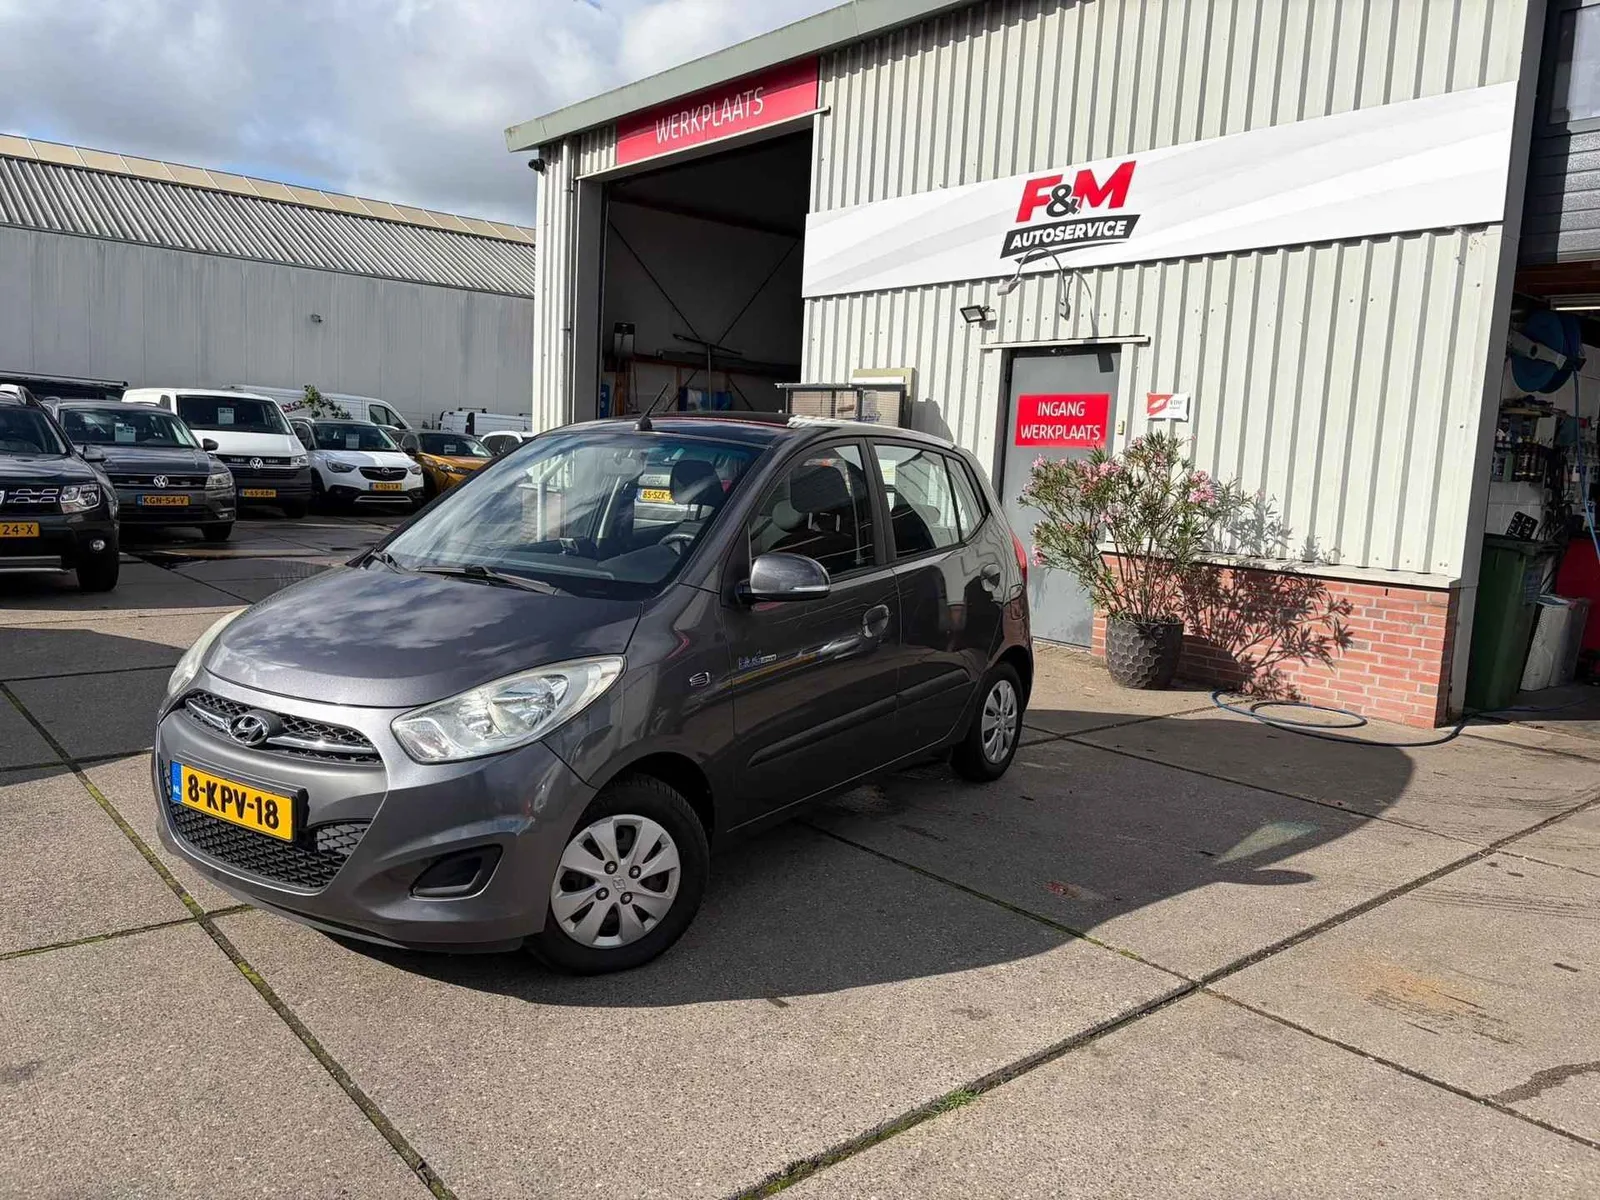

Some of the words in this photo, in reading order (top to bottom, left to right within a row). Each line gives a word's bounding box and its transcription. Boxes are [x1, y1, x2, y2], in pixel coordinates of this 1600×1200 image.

[656, 86, 764, 144] WERKPLAATS
[1015, 160, 1137, 223] F&M
[1009, 220, 1128, 250] AUTOSERVICE
[1037, 401, 1086, 416] INGANG
[1020, 424, 1101, 440] WERKPLAATS
[143, 496, 186, 504] KGN-54-V
[2, 524, 34, 535] 24-X
[187, 773, 280, 830] 8-KPV-18
